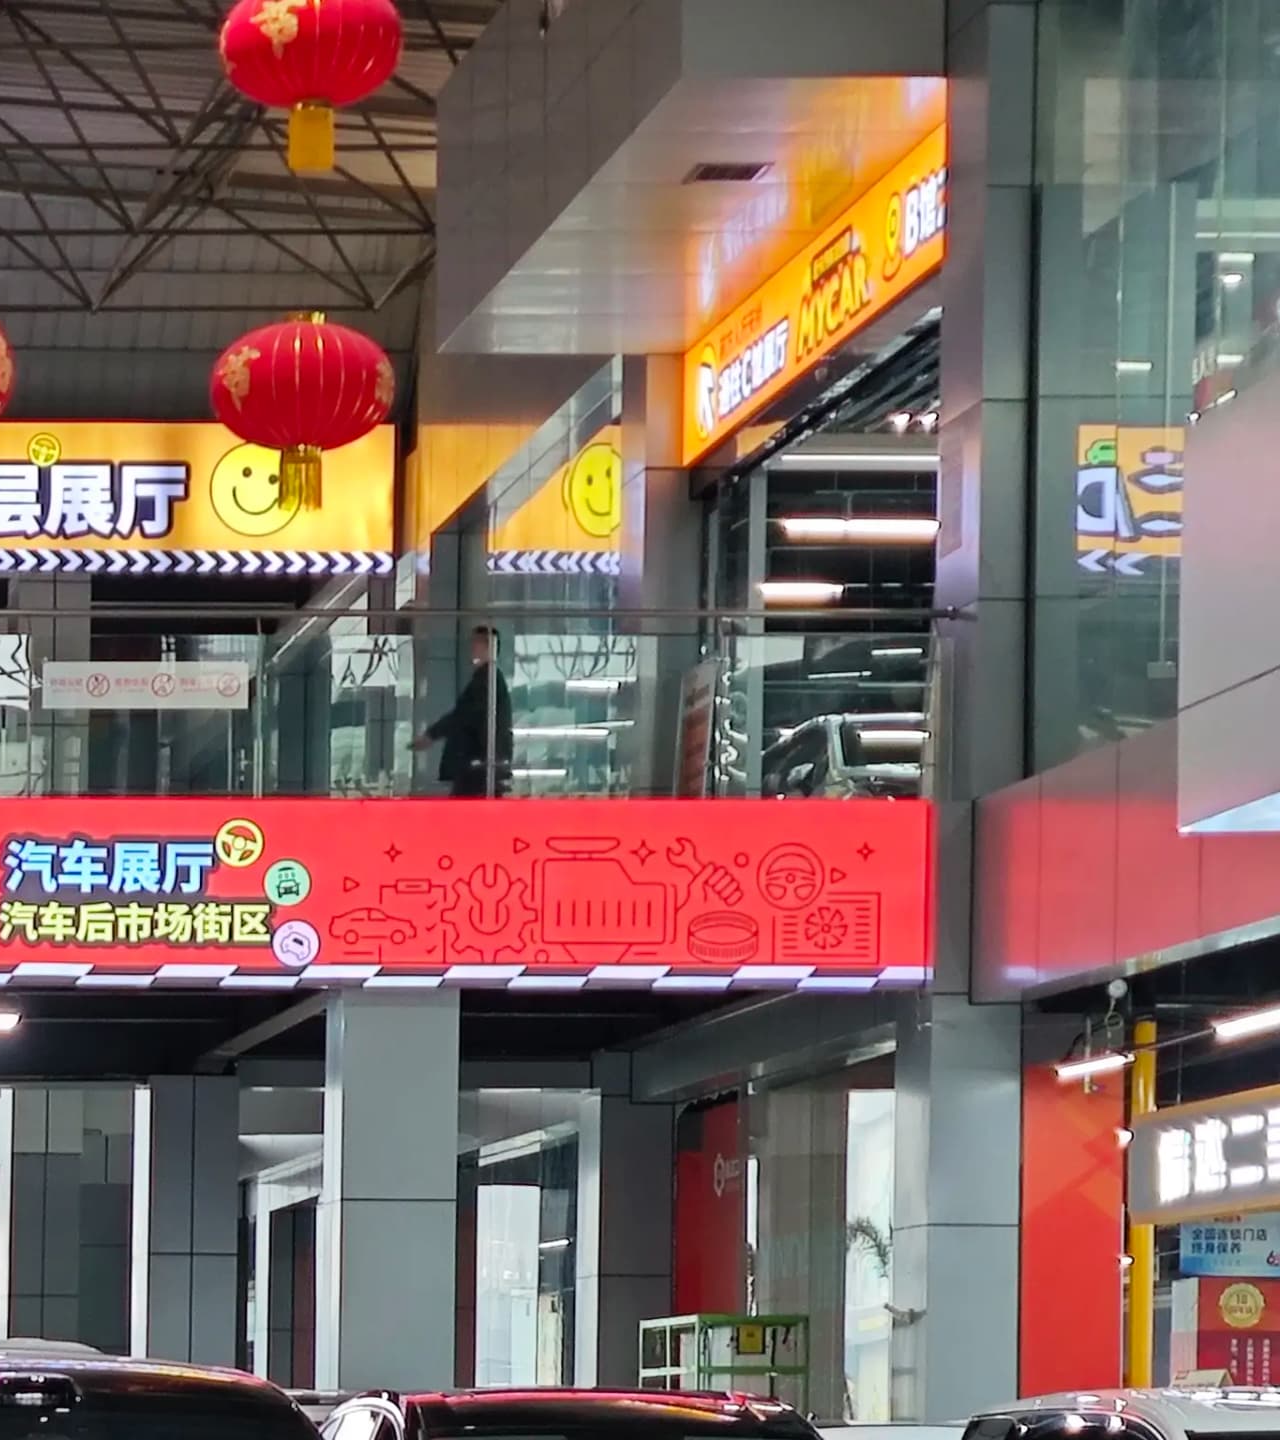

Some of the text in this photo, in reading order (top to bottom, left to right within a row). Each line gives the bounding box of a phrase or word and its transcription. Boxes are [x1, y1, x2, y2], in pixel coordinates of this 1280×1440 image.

[796, 250, 870, 362] MYCAR
[3, 839, 215, 894] 汽车展厅
